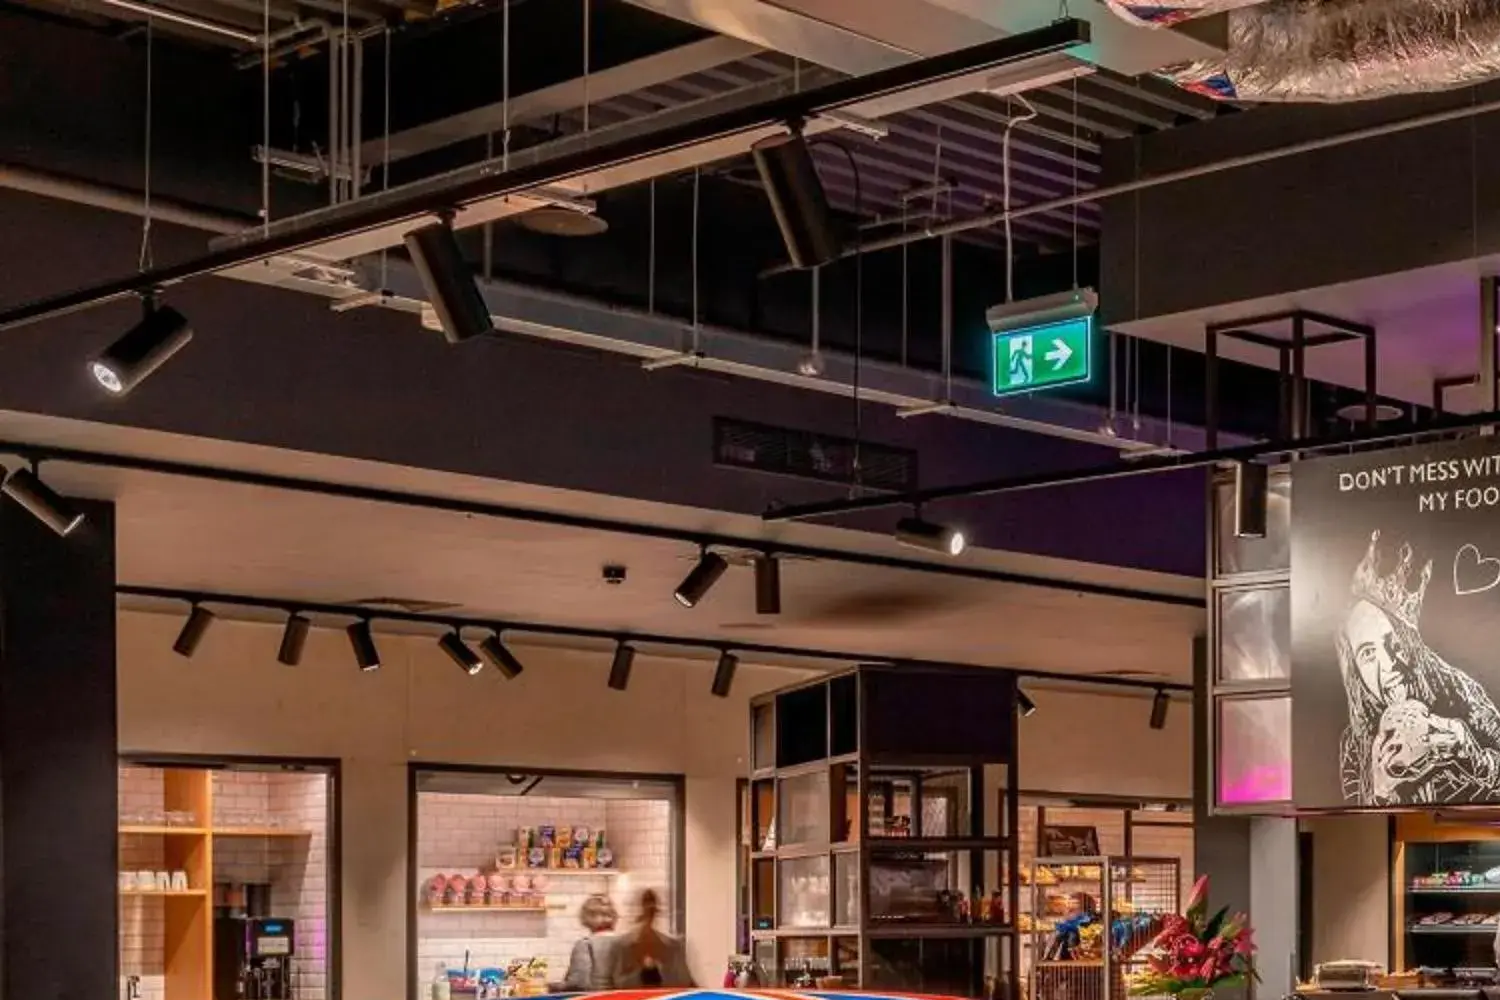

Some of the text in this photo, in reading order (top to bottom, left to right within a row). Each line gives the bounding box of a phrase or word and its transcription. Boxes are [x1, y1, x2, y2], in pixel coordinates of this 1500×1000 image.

[1339, 464, 1406, 492] DON'T
[1409, 460, 1460, 484] MESS
[1419, 492, 1449, 513] MY
